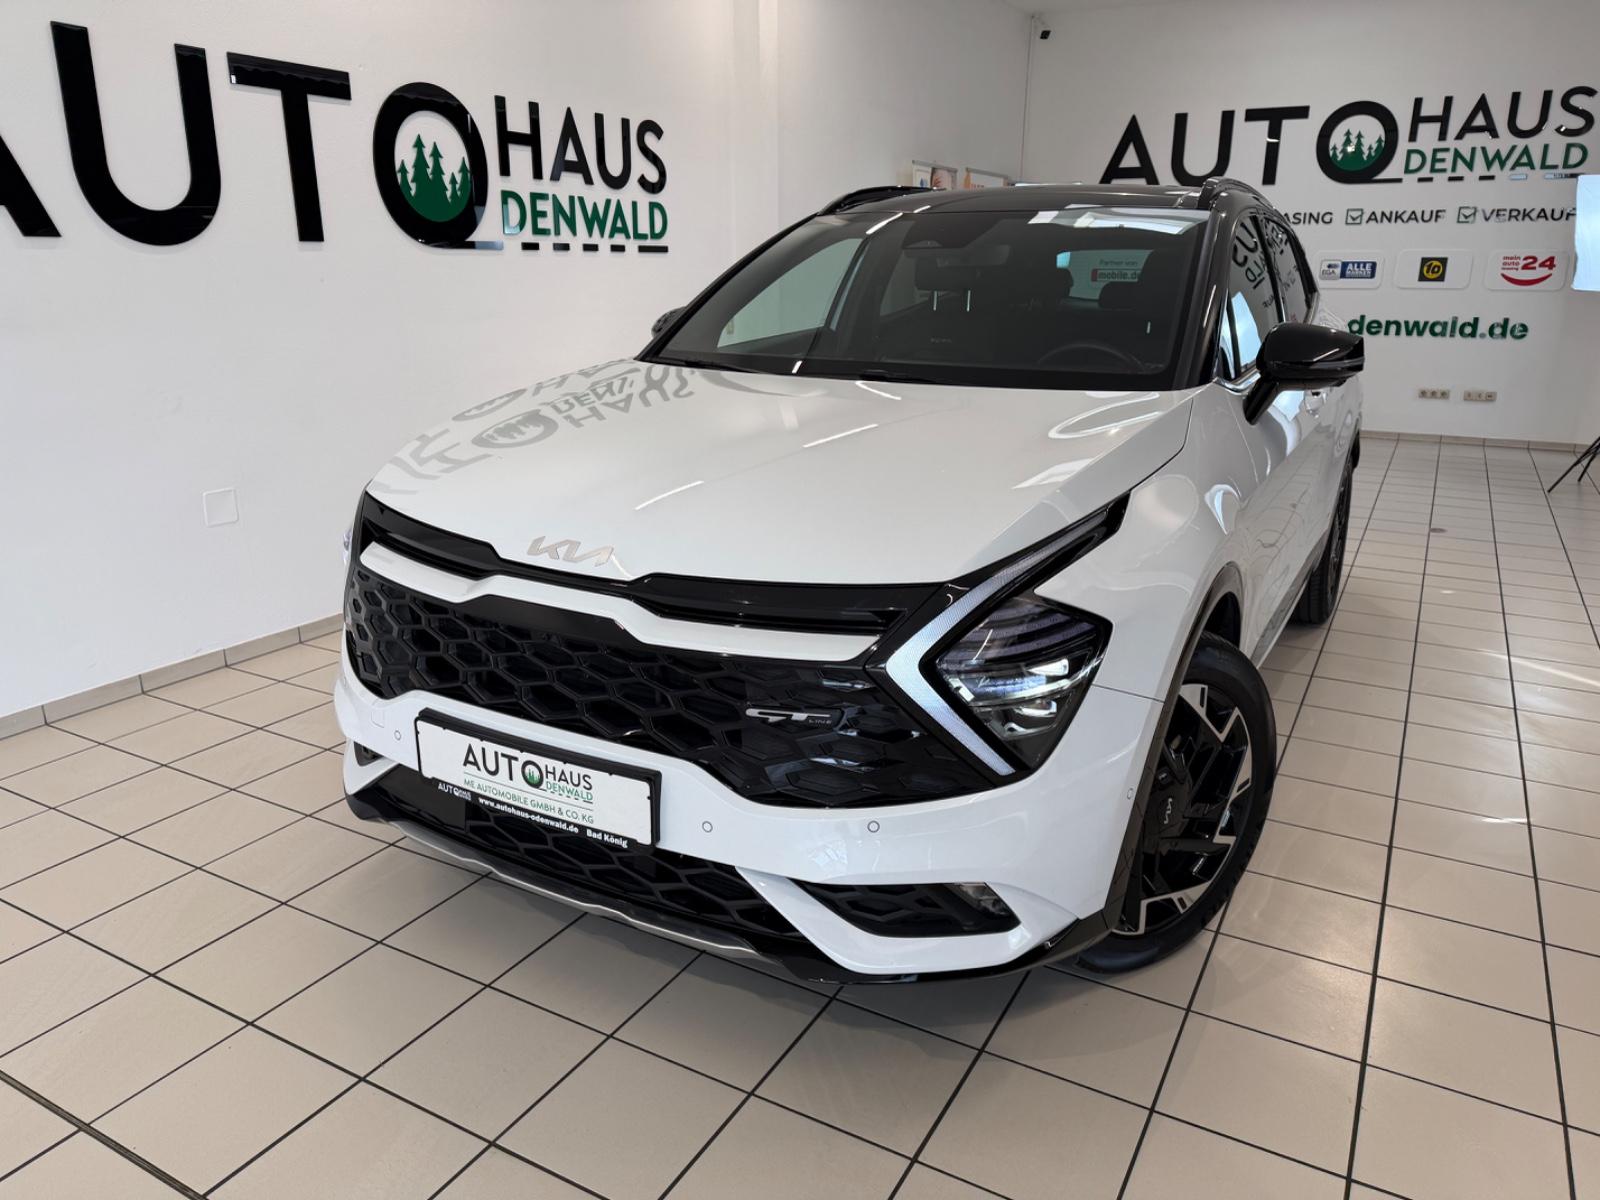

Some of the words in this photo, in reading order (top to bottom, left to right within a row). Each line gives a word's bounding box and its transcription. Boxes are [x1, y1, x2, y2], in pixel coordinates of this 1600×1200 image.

[494, 95, 667, 195] HAUS
[1099, 99, 1399, 186] AUTO
[1407, 85, 1598, 143] HAUS
[1403, 142, 1589, 175] DENWALD
[499, 189, 668, 241] DENWALD
[1366, 208, 1446, 224] ANKAUF
[1346, 262, 1374, 271] ALLE
[1521, 255, 1557, 271] 24
[1347, 315, 1529, 340] denwald.de
[526, 535, 615, 568] KIA
[463, 743, 544, 789] AUTO
[544, 763, 593, 791] HAUS
[464, 778, 476, 787] ME
[477, 783, 529, 806] AUTOMOBILE
[530, 799, 556, 812] GMBH
[557, 807, 564, 816] &
[565, 809, 580, 821] CO.
[581, 813, 594, 824] KG
[545, 780, 593, 801] DENWALD
[478, 797, 579, 834] www.autohaus-odenwald.de
[586, 828, 602, 840] Bad
[603, 833, 628, 848] König
